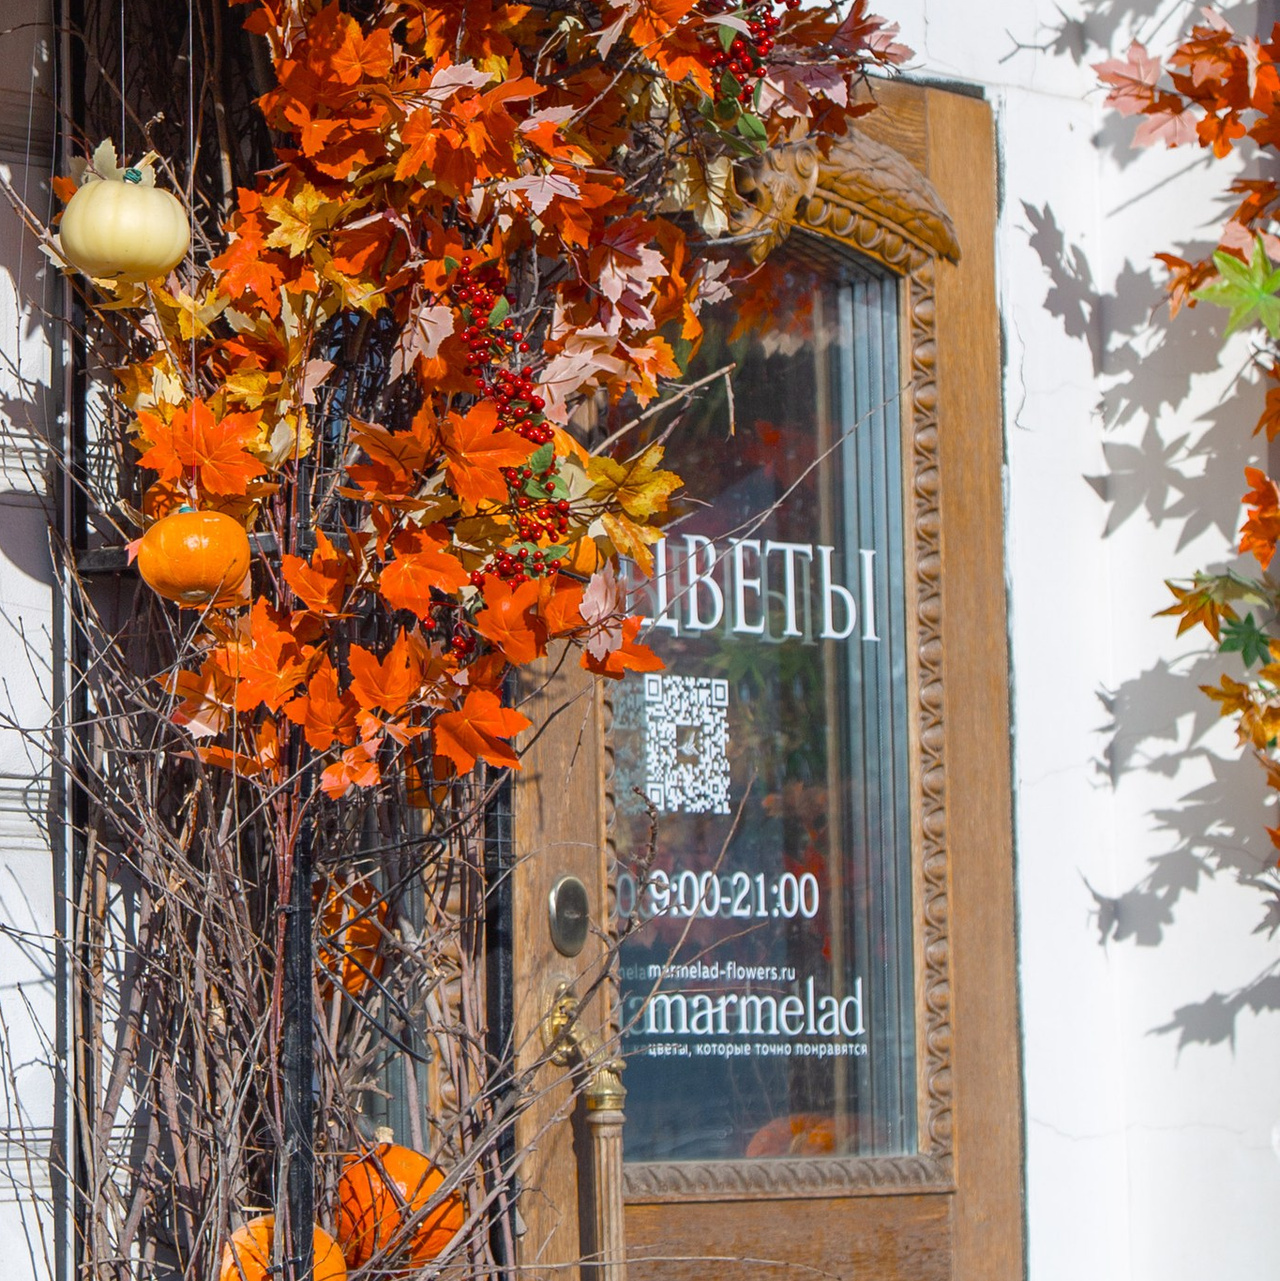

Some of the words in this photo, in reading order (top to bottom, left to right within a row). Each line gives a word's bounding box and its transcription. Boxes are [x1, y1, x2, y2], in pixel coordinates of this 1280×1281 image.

[649, 870, 819, 918] 9:00-21:00
[648, 960, 796, 981] marmelad-flowers.ru
[647, 976, 866, 1036] marmelad
[648, 1043, 692, 1057] цветы,
[696, 1044, 751, 1059] которые
[755, 1044, 792, 1056] точно
[795, 1043, 868, 1059] понравятся
